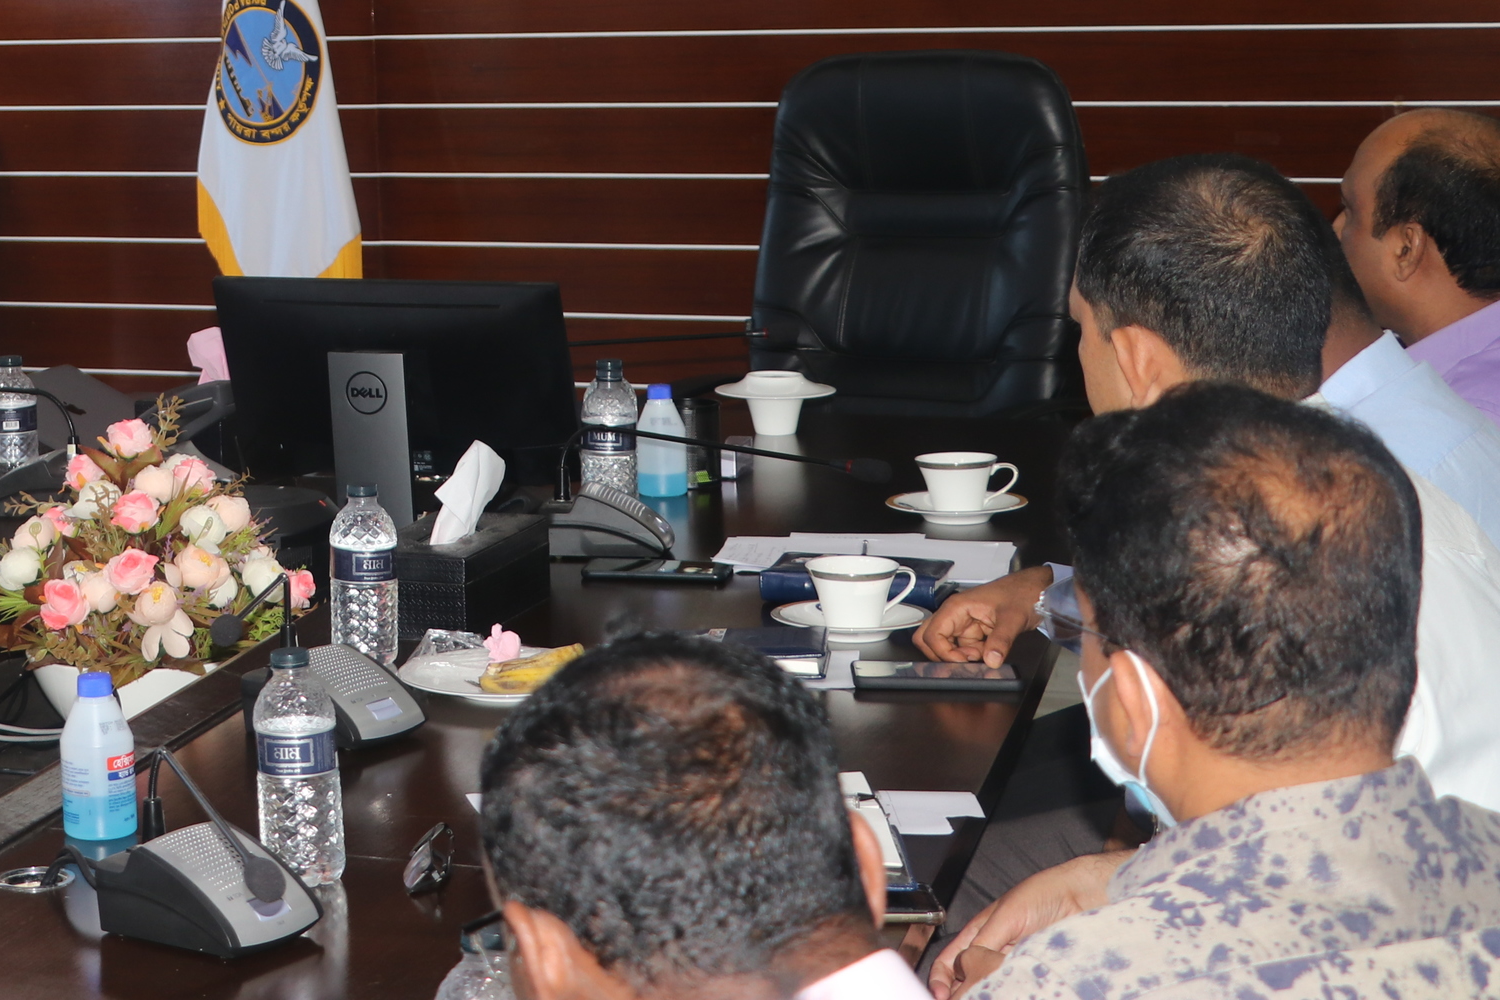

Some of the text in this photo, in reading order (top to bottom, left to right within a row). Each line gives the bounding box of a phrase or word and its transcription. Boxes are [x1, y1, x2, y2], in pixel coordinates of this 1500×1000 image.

[227, 113, 258, 139] পায়রা
[260, 121, 290, 139] বন্দর
[351, 387, 383, 398] DELL
[593, 431, 617, 441] MUM
